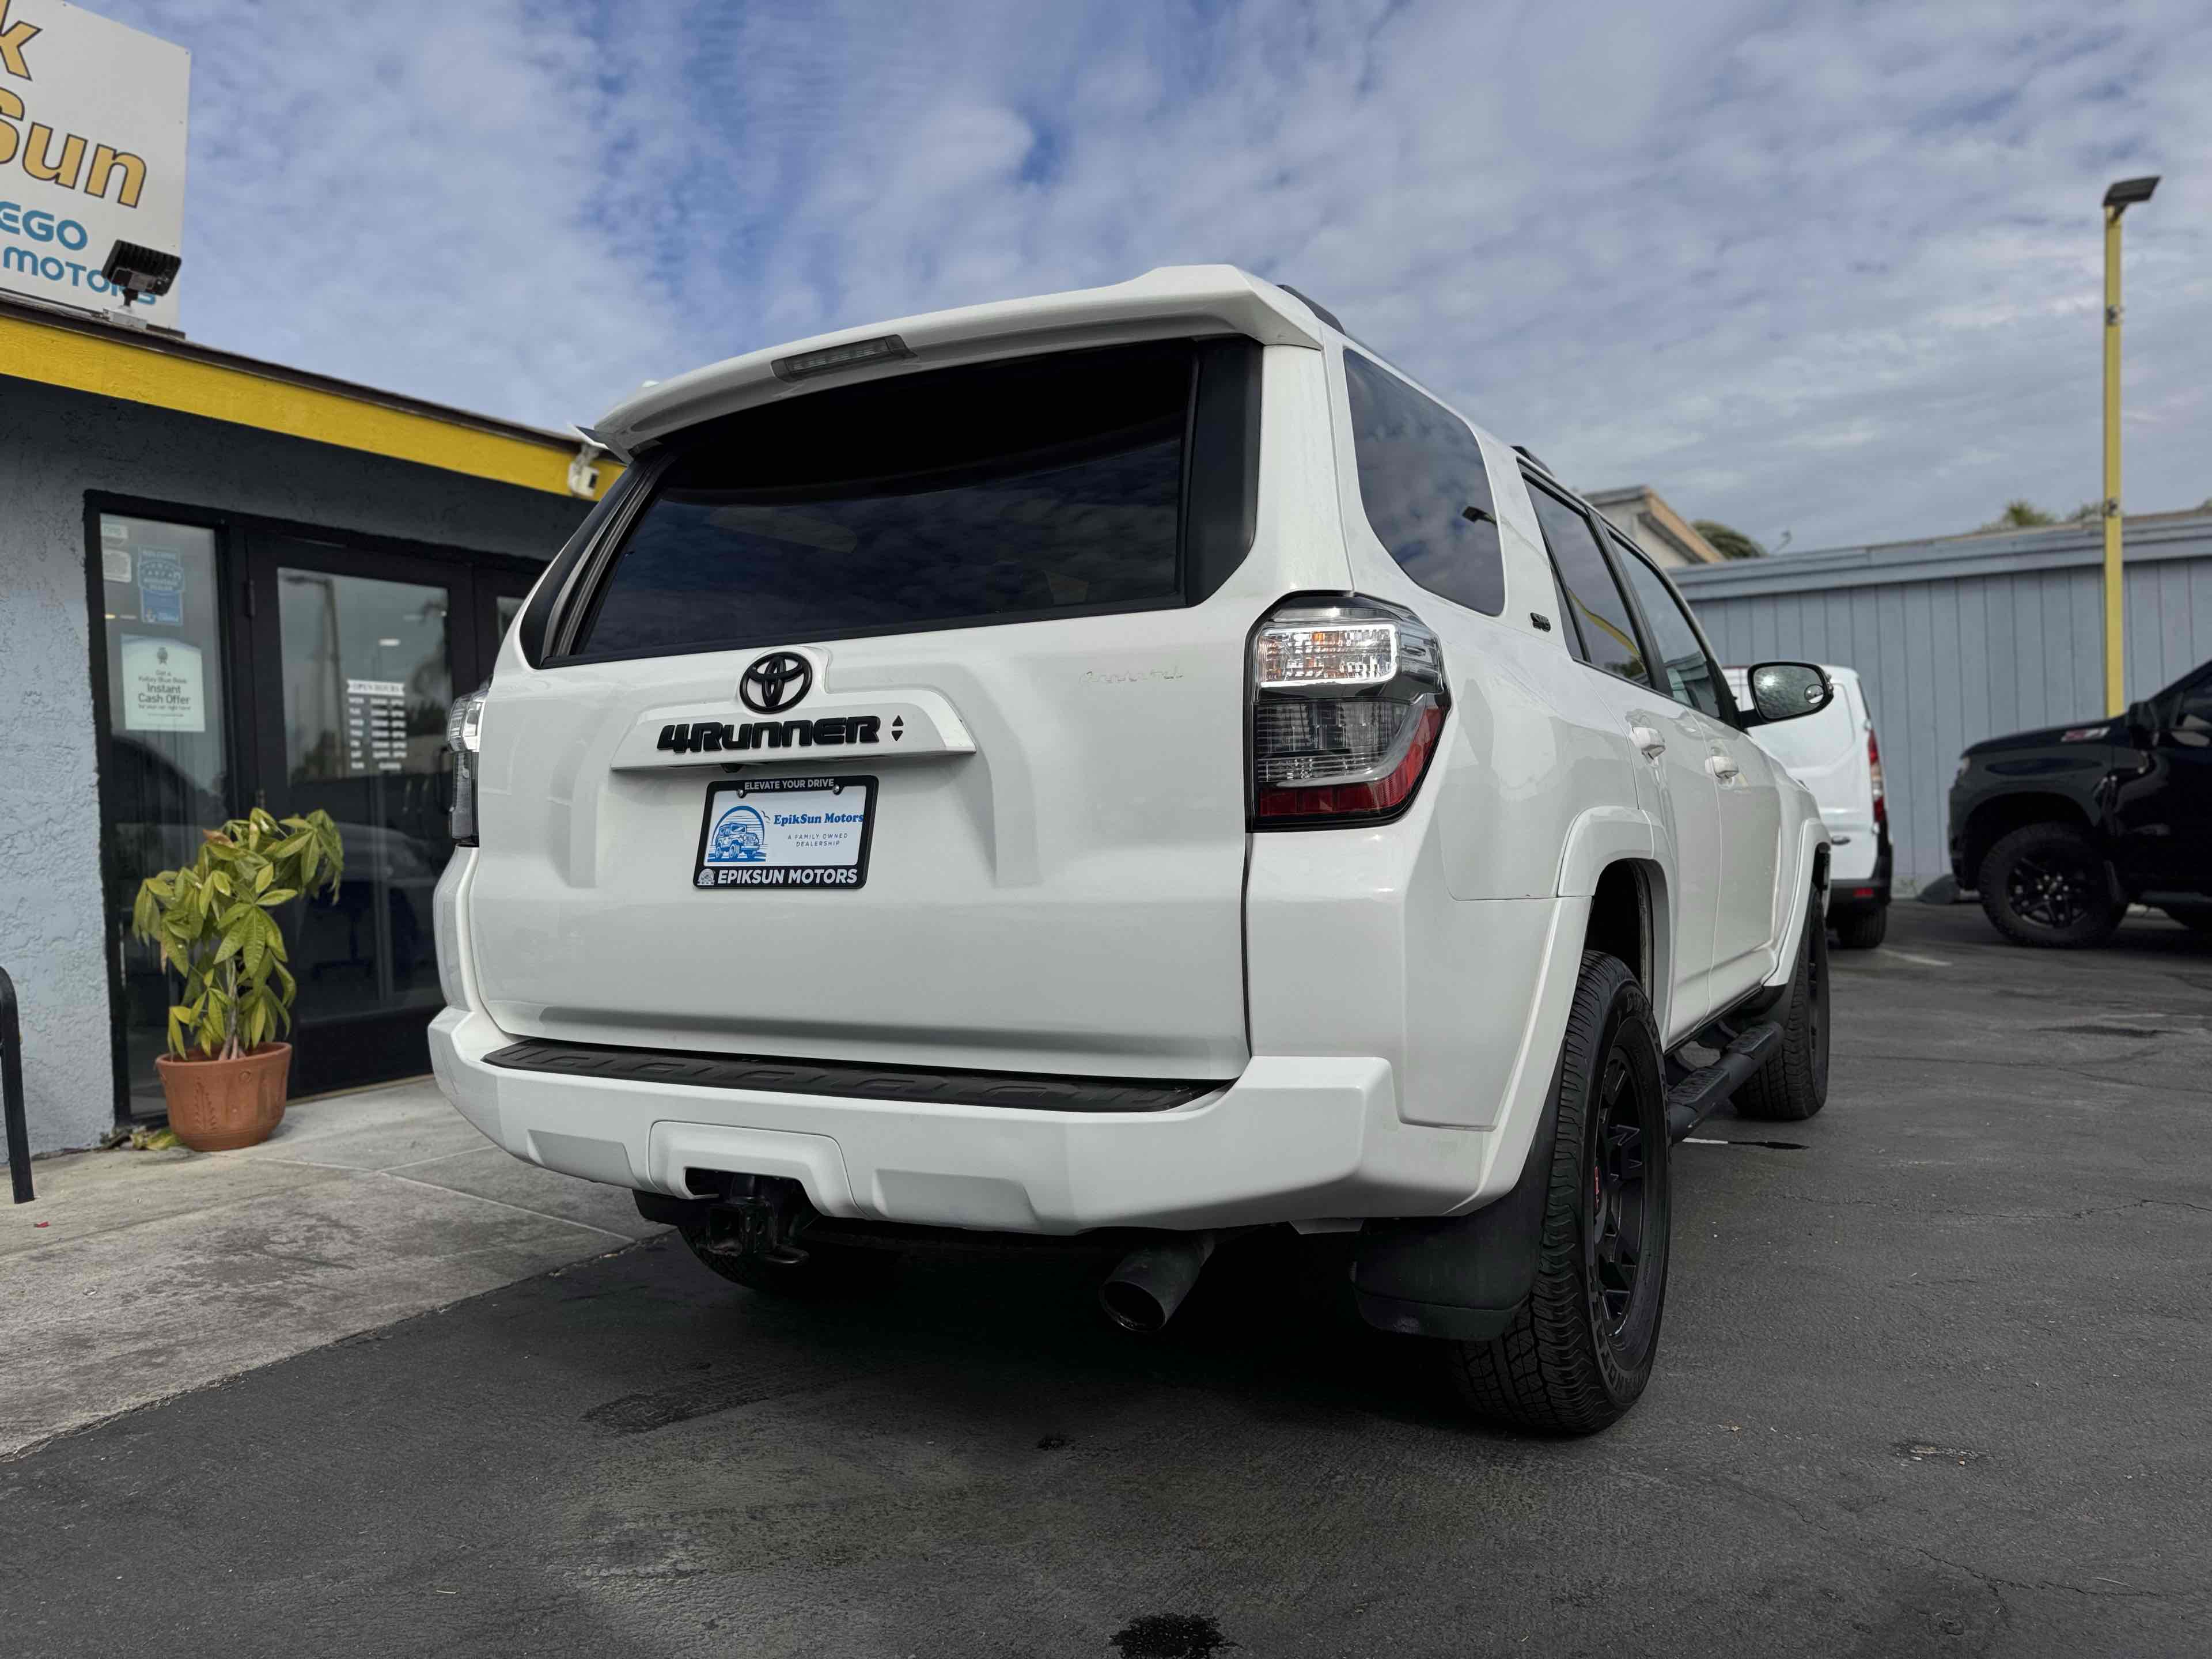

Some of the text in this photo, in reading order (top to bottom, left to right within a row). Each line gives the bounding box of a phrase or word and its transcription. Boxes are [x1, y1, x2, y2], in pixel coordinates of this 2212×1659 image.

[147, 683, 181, 693] Instant
[138, 693, 190, 704] Cash Offer
[657, 715, 881, 753] 4RUNNER
[744, 778, 835, 790] ELEVATE YOUR DRIVE
[774, 813, 864, 827] EpikSun Motors
[718, 869, 858, 884] EPIKSUN MOTORS
